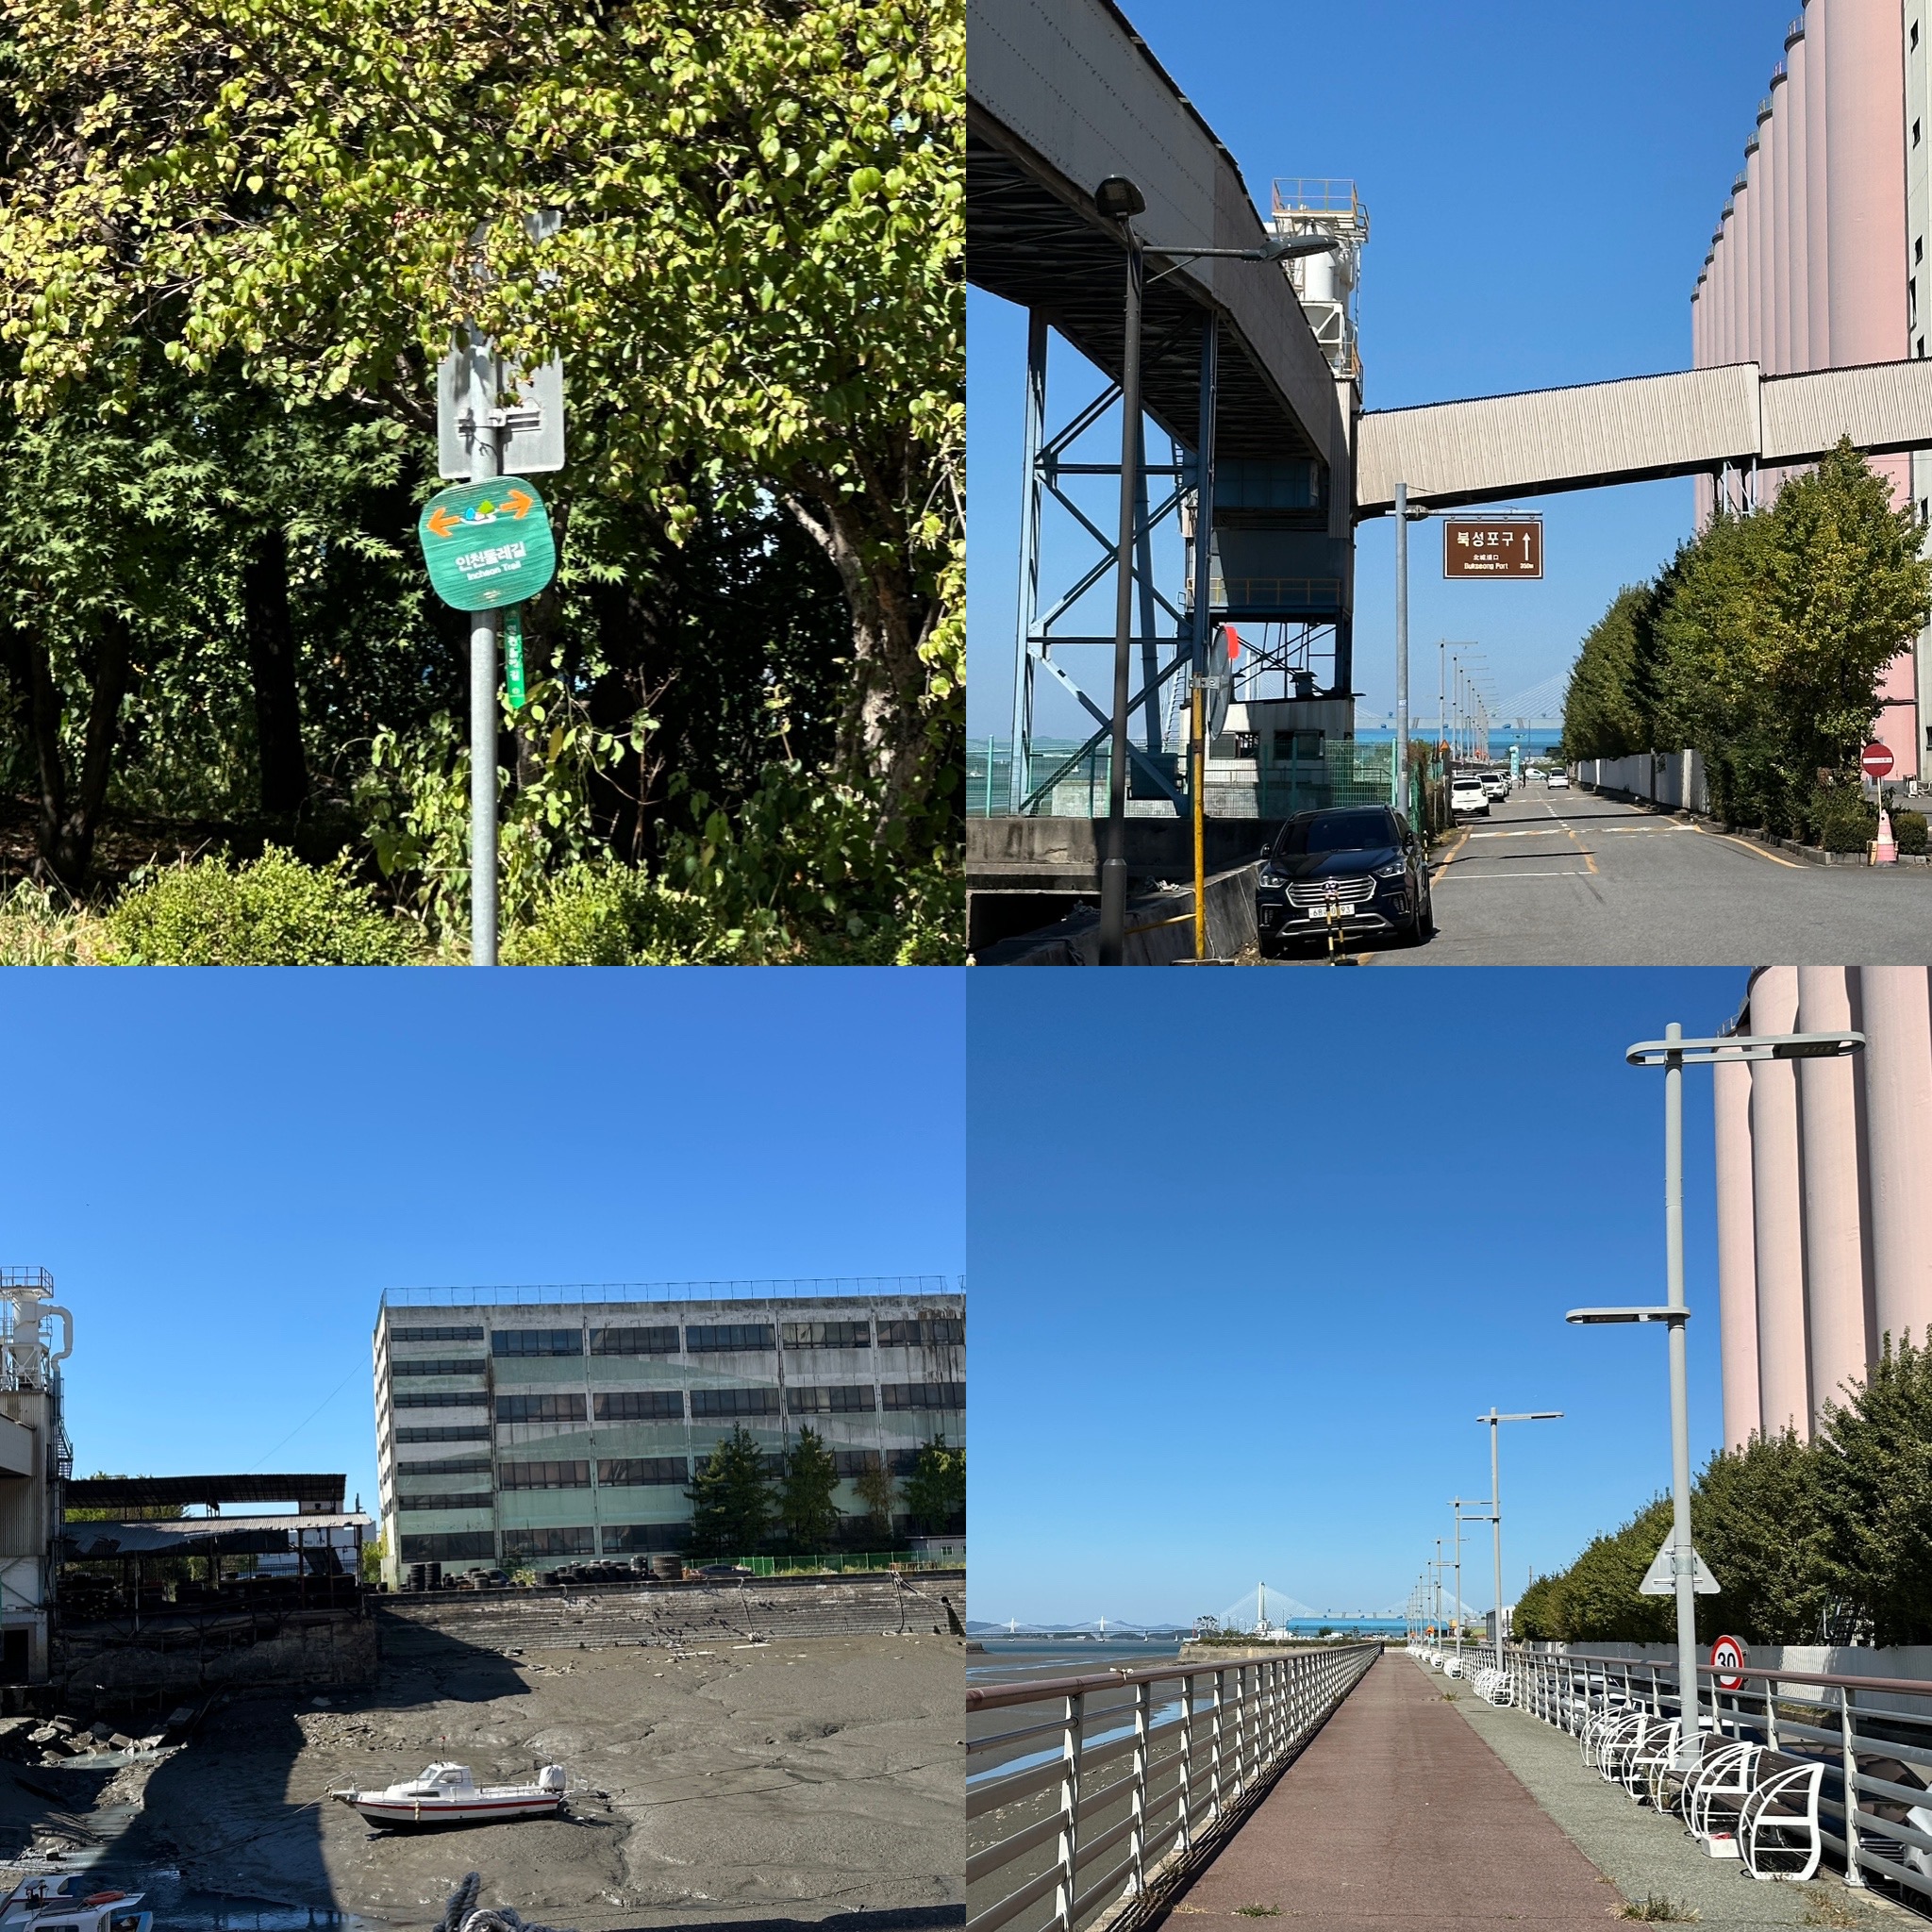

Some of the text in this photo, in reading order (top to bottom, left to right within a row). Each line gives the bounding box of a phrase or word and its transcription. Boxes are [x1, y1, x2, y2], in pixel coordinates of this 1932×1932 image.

[1457, 531, 1514, 547] 북성포구
[455, 541, 527, 572] 인천둘레길
[466, 560, 522, 581] Incheon Trail
[1717, 1652, 1737, 1668] 30
